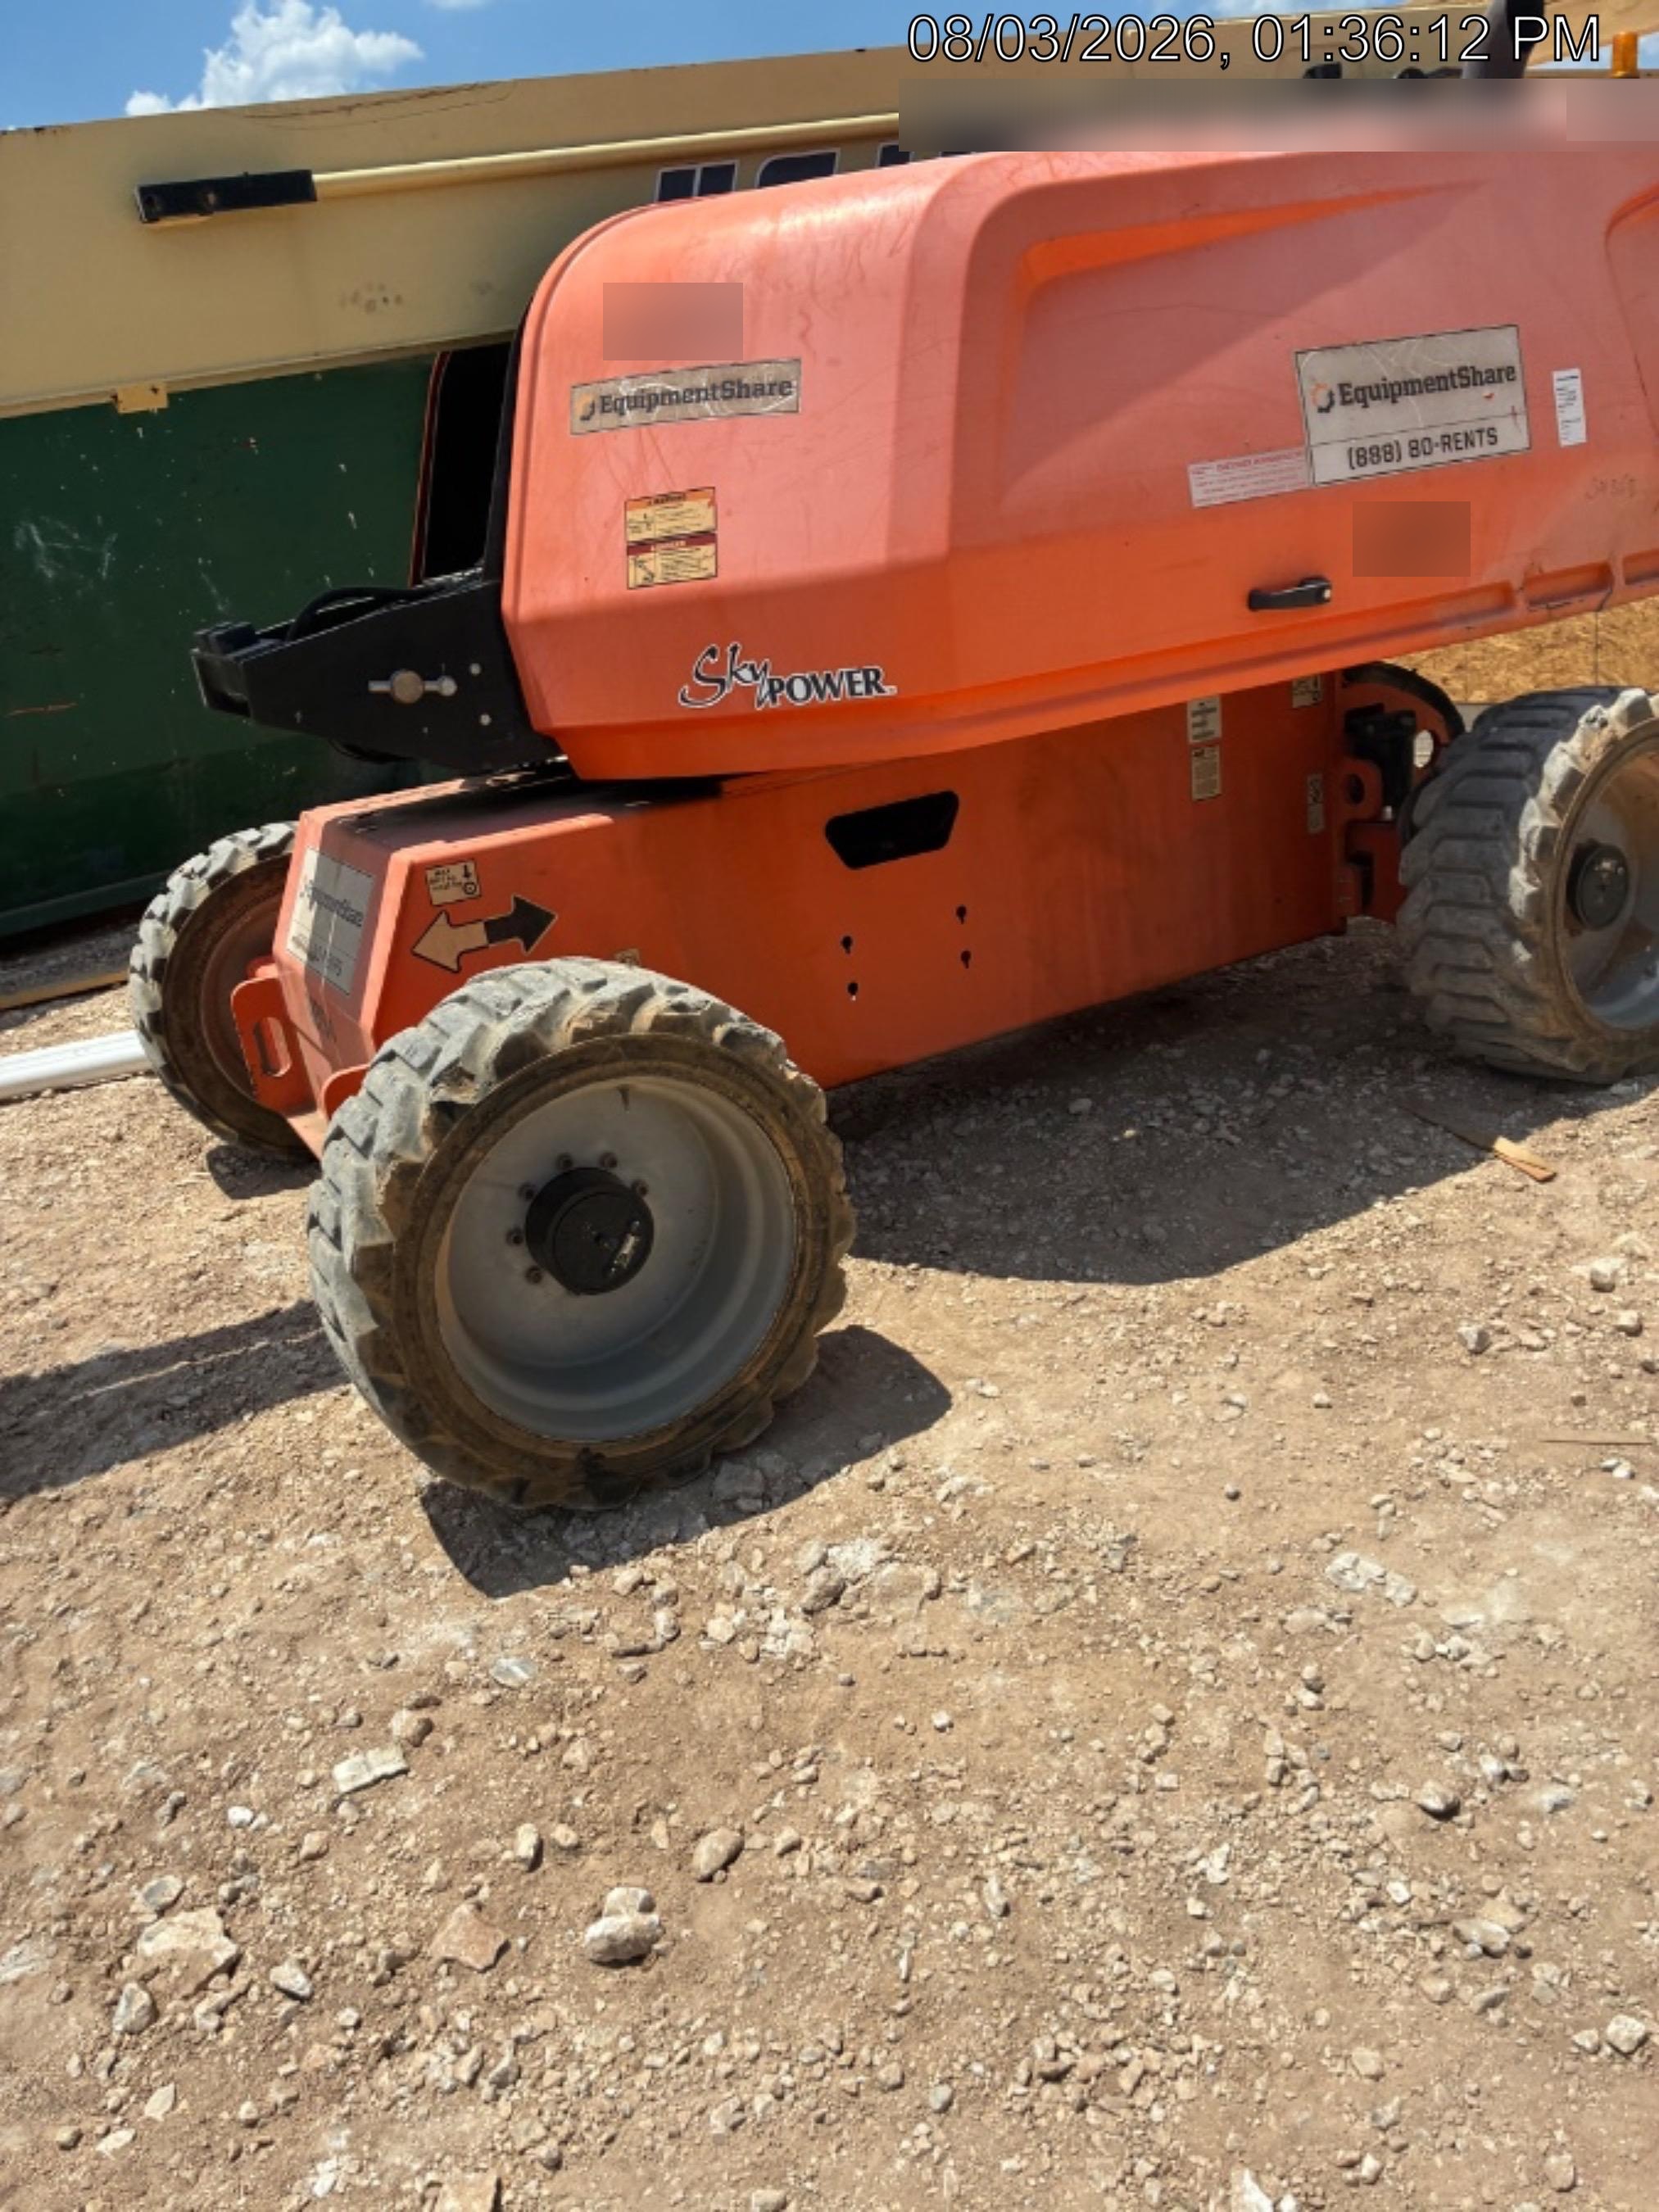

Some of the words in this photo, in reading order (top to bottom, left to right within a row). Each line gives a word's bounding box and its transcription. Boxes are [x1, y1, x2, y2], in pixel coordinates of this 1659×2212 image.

[598, 378, 793, 418] EquipmentShare
[1338, 365, 1517, 409] EquipmentShare
[1347, 440, 1403, 470] (888)
[1407, 426, 1498, 459] 80-RENTS
